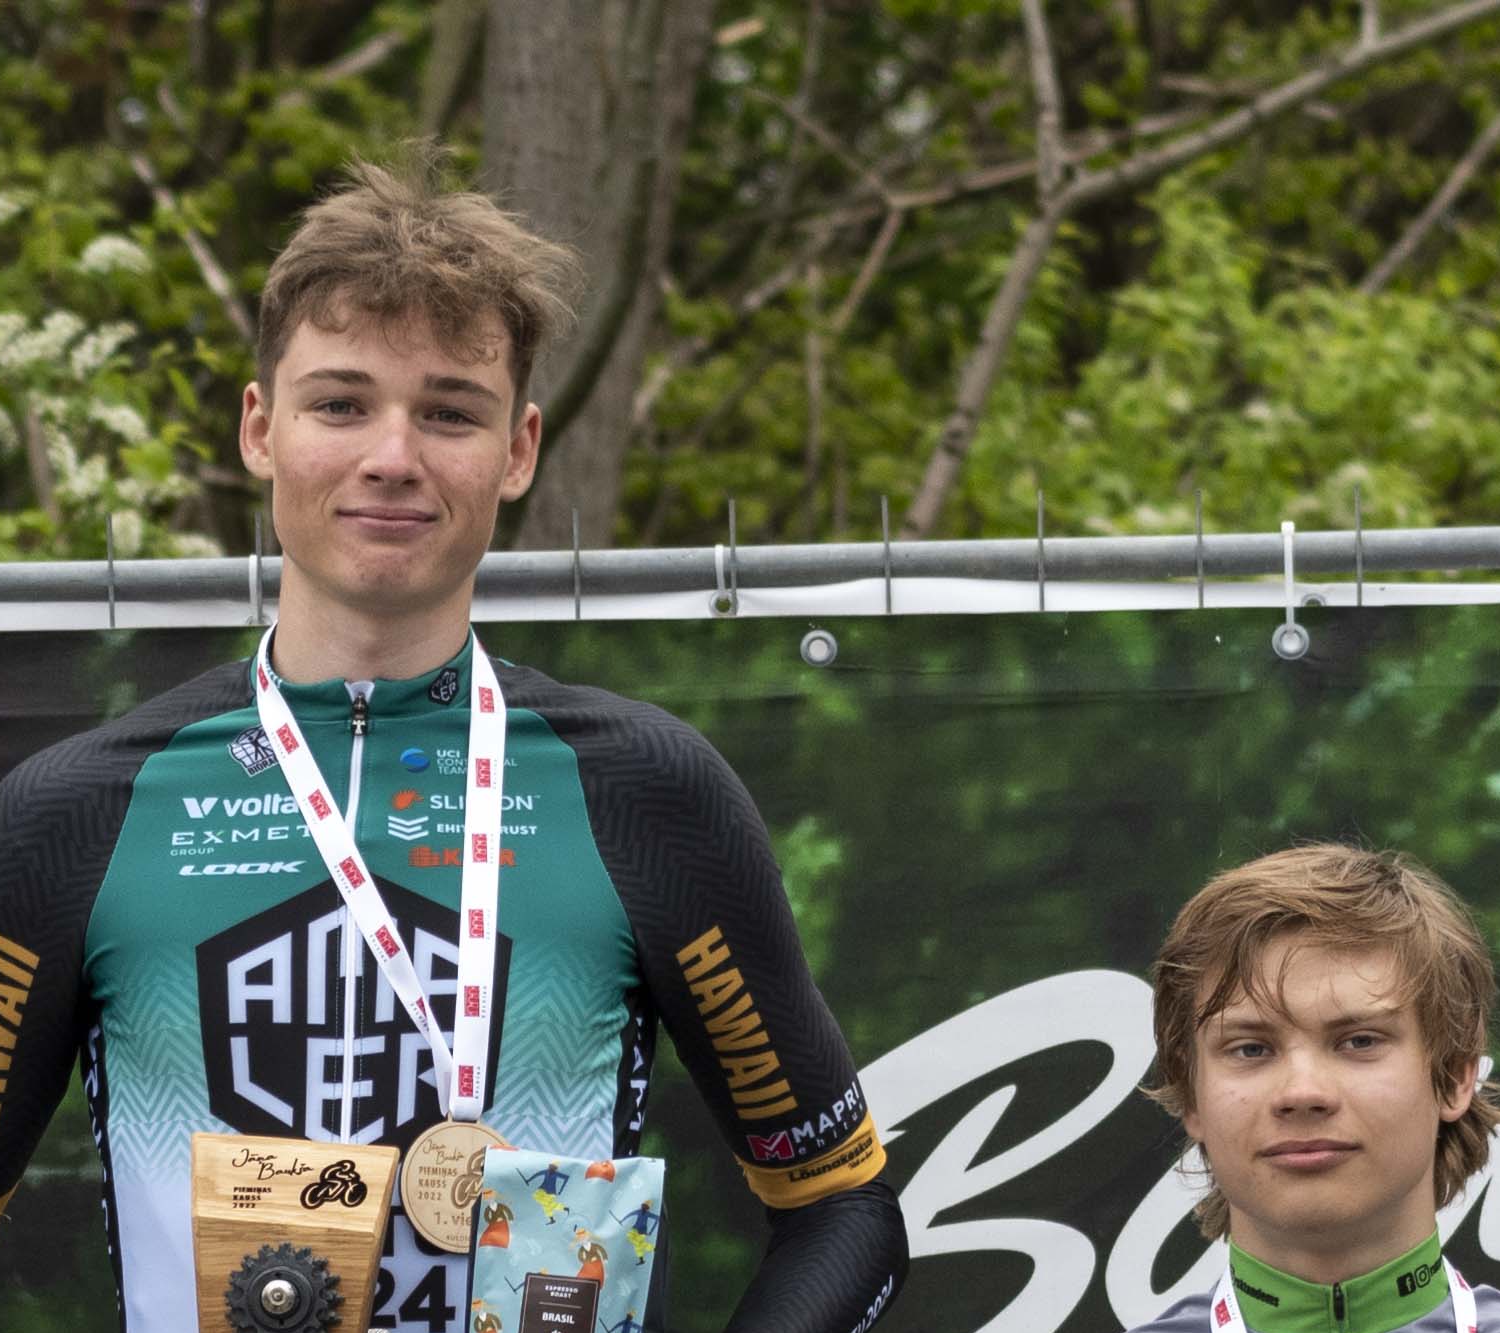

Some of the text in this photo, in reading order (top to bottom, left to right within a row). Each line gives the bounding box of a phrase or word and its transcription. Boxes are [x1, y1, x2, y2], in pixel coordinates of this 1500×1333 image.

[436, 749, 461, 759] UCI
[170, 846, 215, 857] GROUP
[179, 859, 306, 877] LOOK
[674, 924, 799, 1121] HAWAII
[793, 1079, 861, 1145] MAPRI
[417, 1191, 443, 1201] 2022
[434, 1212, 448, 1226] 1.
[541, 1311, 576, 1325] BRASIL
